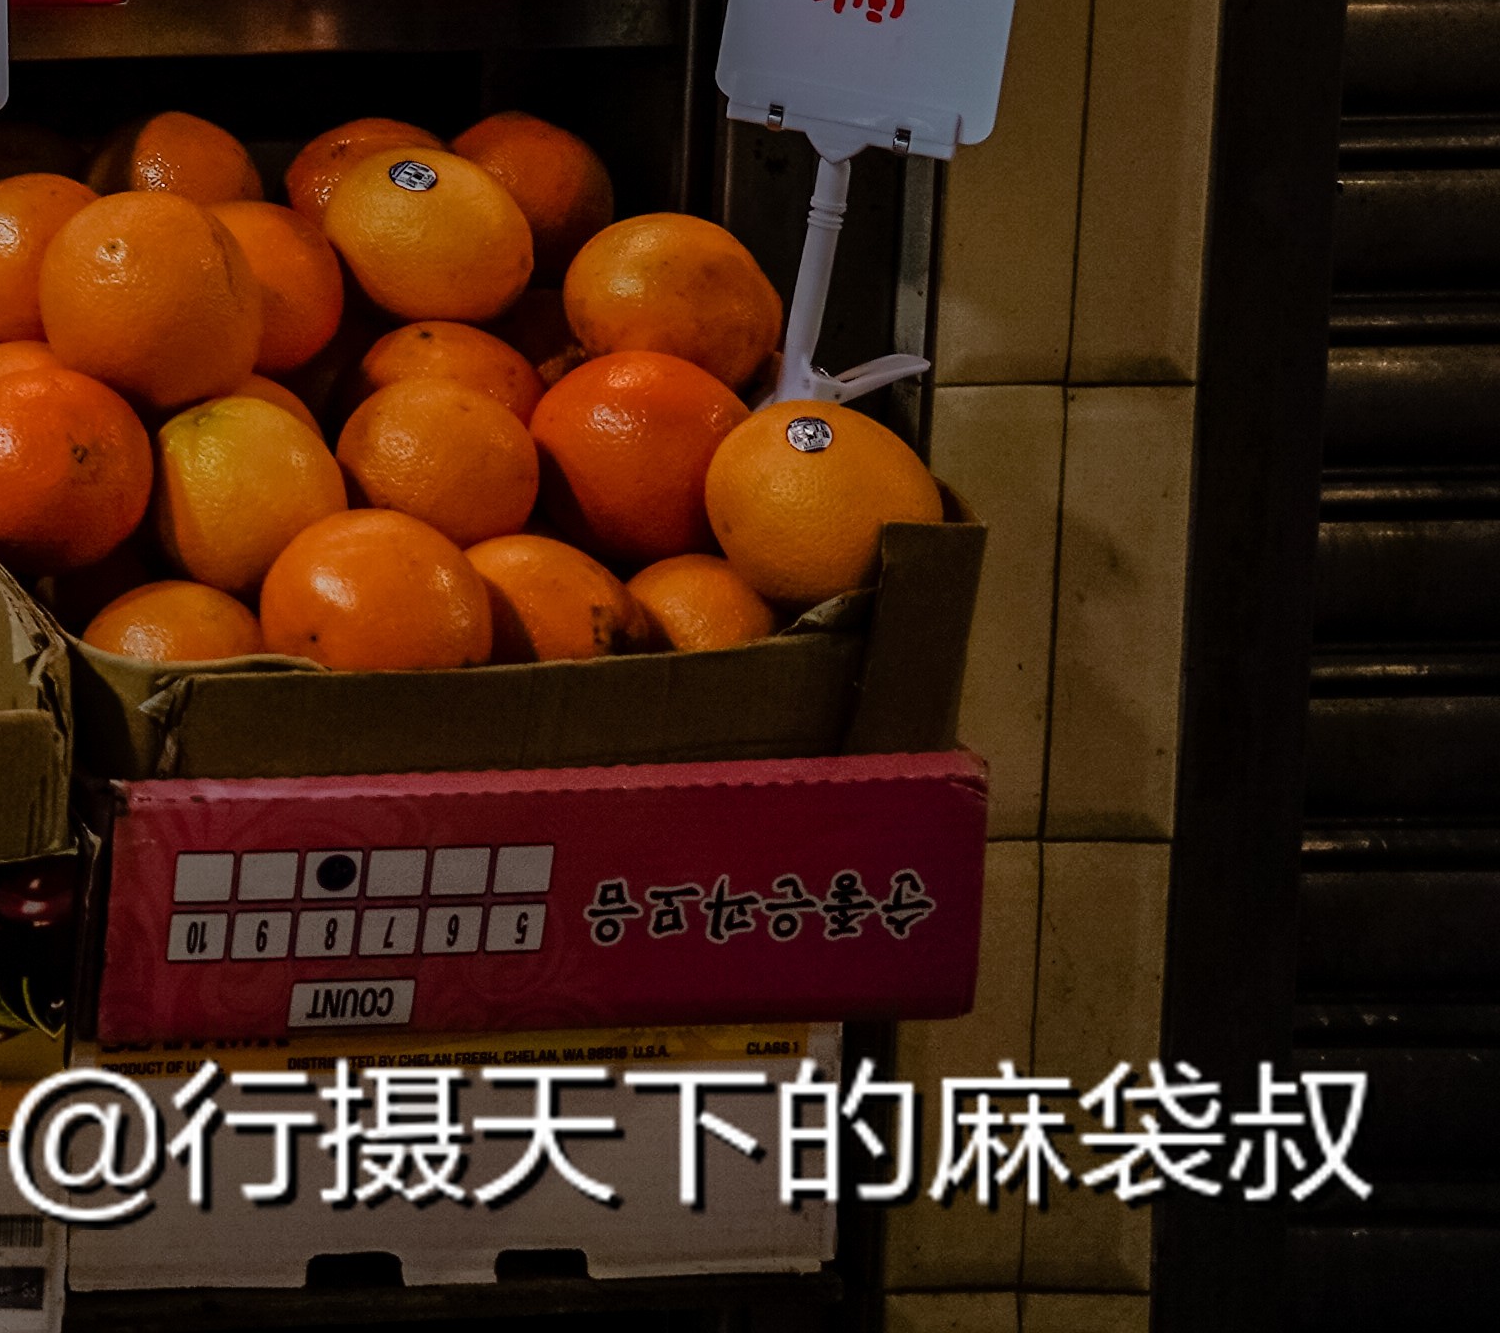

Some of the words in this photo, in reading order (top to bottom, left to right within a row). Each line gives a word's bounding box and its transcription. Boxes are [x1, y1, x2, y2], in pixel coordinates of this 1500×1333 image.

[186, 920, 208, 953] 10
[322, 917, 337, 950] 8
[381, 917, 395, 950] 7
[513, 912, 528, 946] 5
[305, 985, 396, 1020] COUNT
